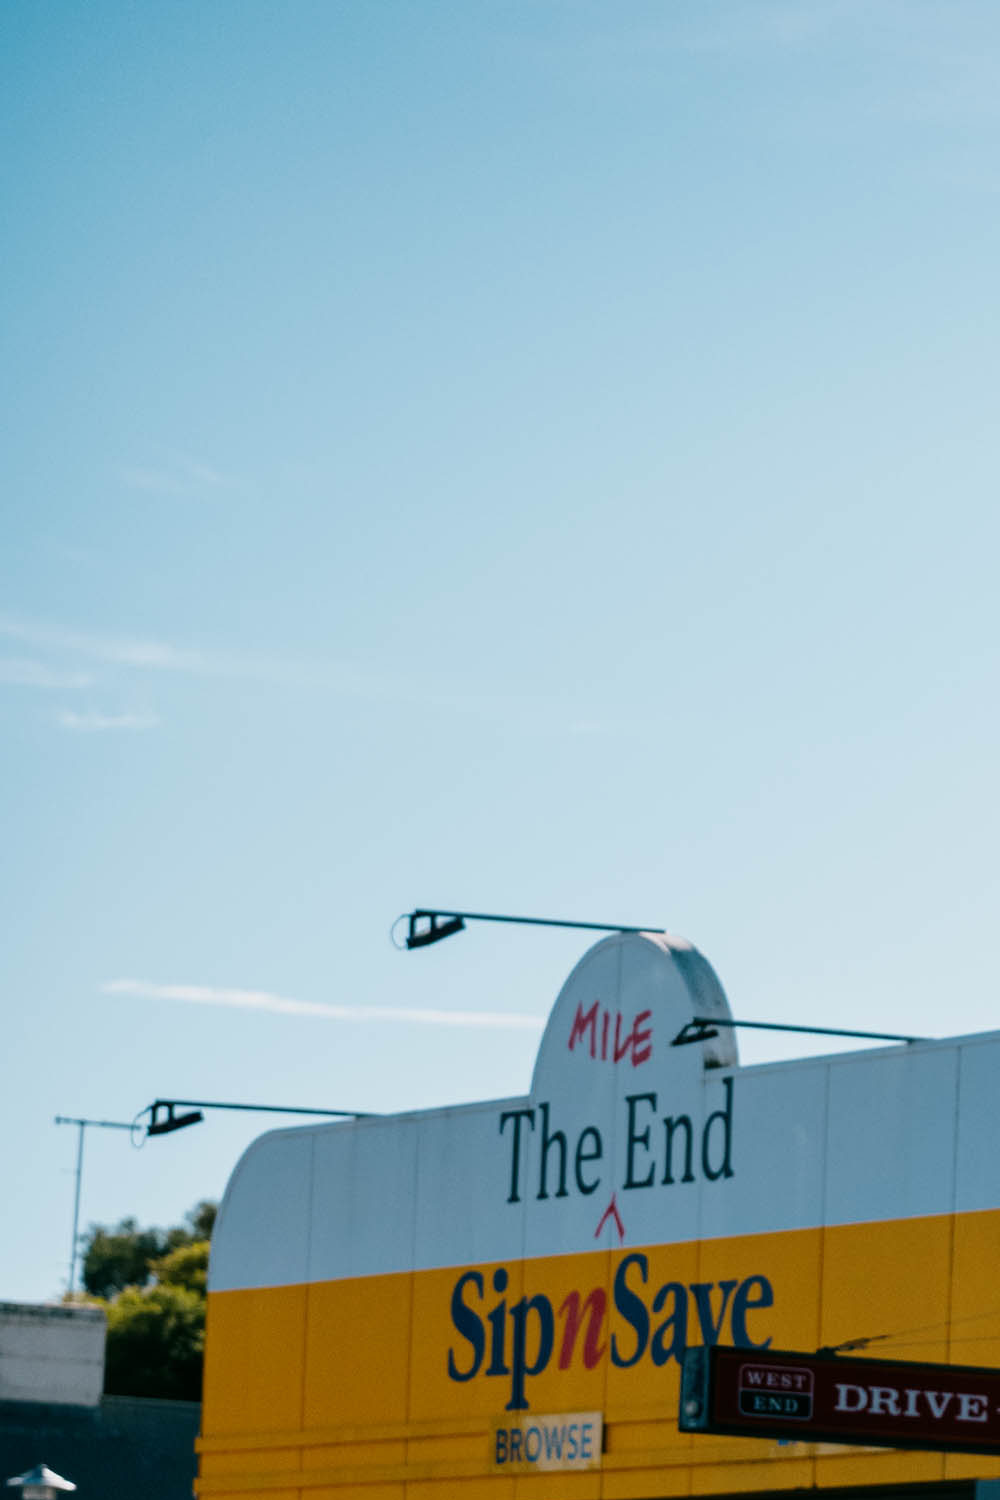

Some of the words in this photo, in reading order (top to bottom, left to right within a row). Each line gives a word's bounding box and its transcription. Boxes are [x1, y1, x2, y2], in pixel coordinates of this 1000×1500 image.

[567, 1000, 653, 1068] MILE
[499, 1101, 603, 1204] The
[622, 1076, 735, 1190] End
[747, 1370, 807, 1389] WEST
[753, 1397, 800, 1414] END
[495, 1424, 593, 1464] BROWSE
